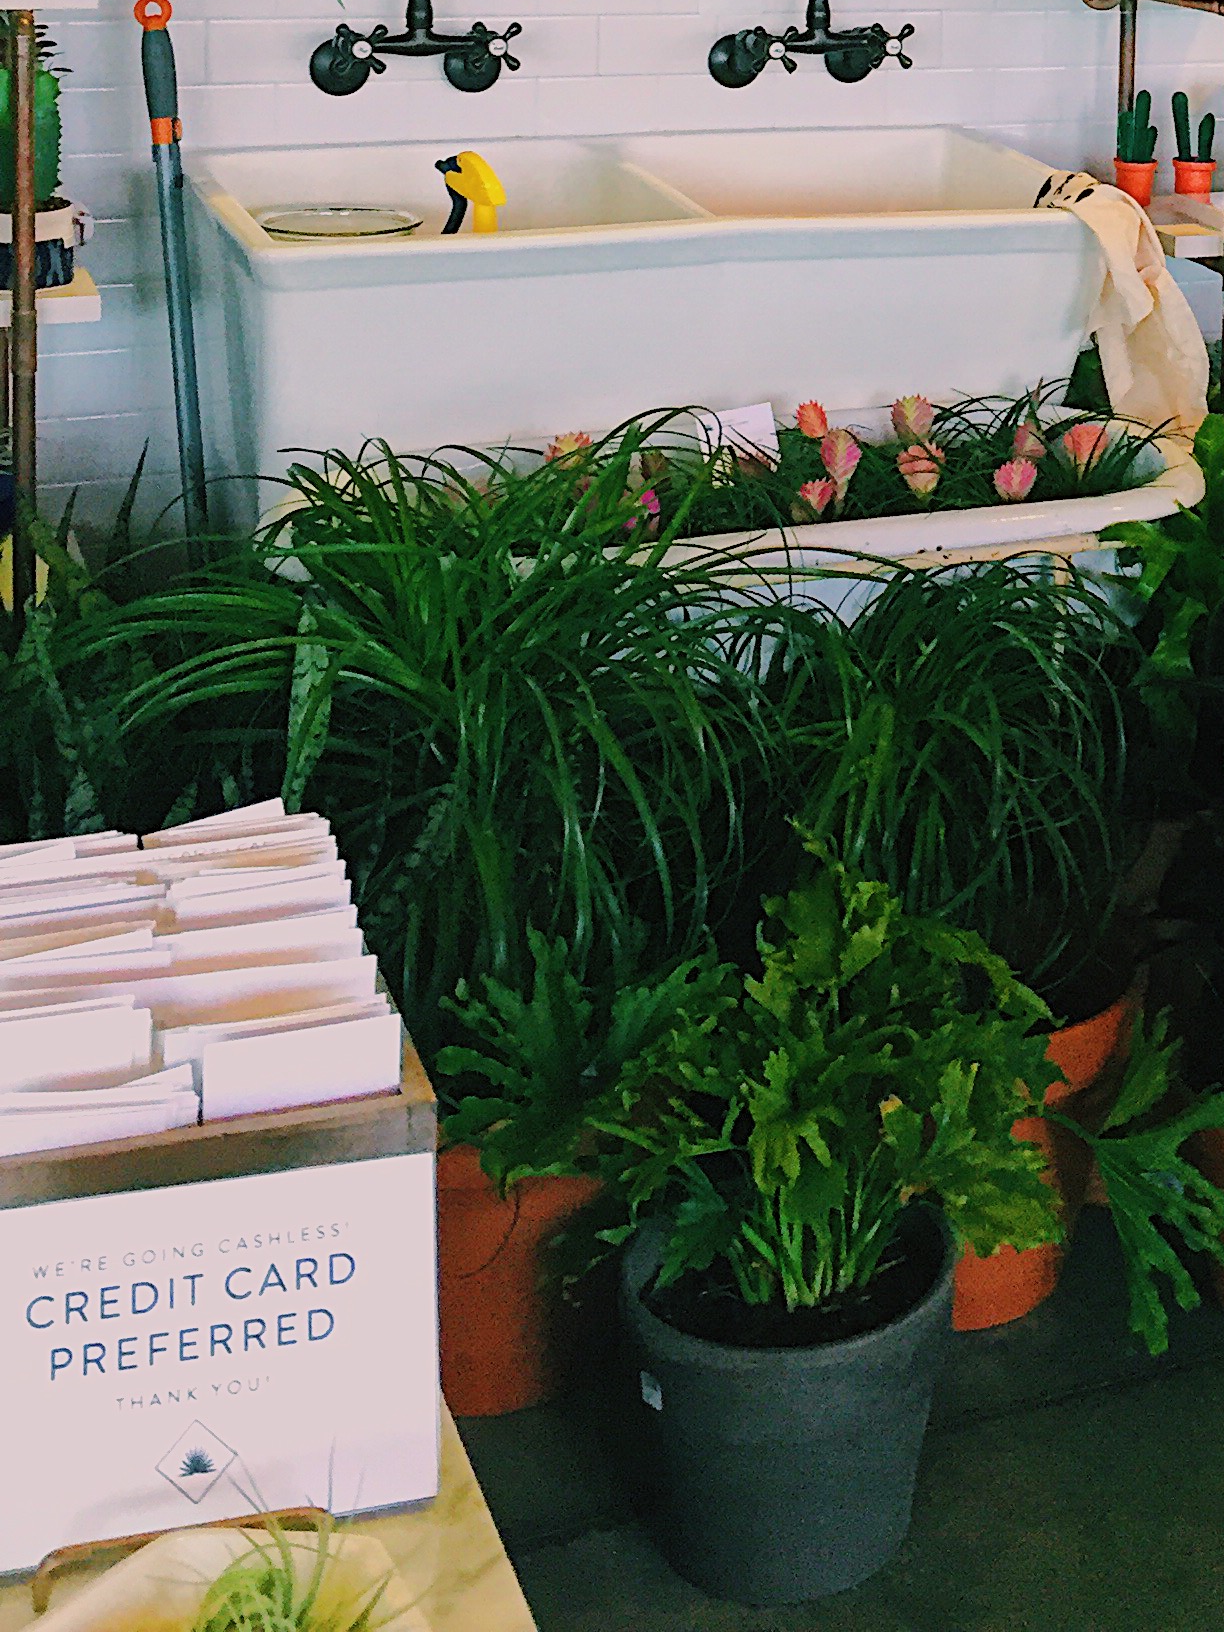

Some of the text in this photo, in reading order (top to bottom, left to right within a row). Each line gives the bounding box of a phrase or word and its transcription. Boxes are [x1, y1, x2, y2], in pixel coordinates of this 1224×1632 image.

[32, 1255, 108, 1280] WE'RE
[122, 1242, 204, 1267] GOING
[25, 1251, 357, 1329] CREDIT CARD
[49, 1308, 335, 1382] PREFERRED
[115, 1386, 198, 1410] THANK
